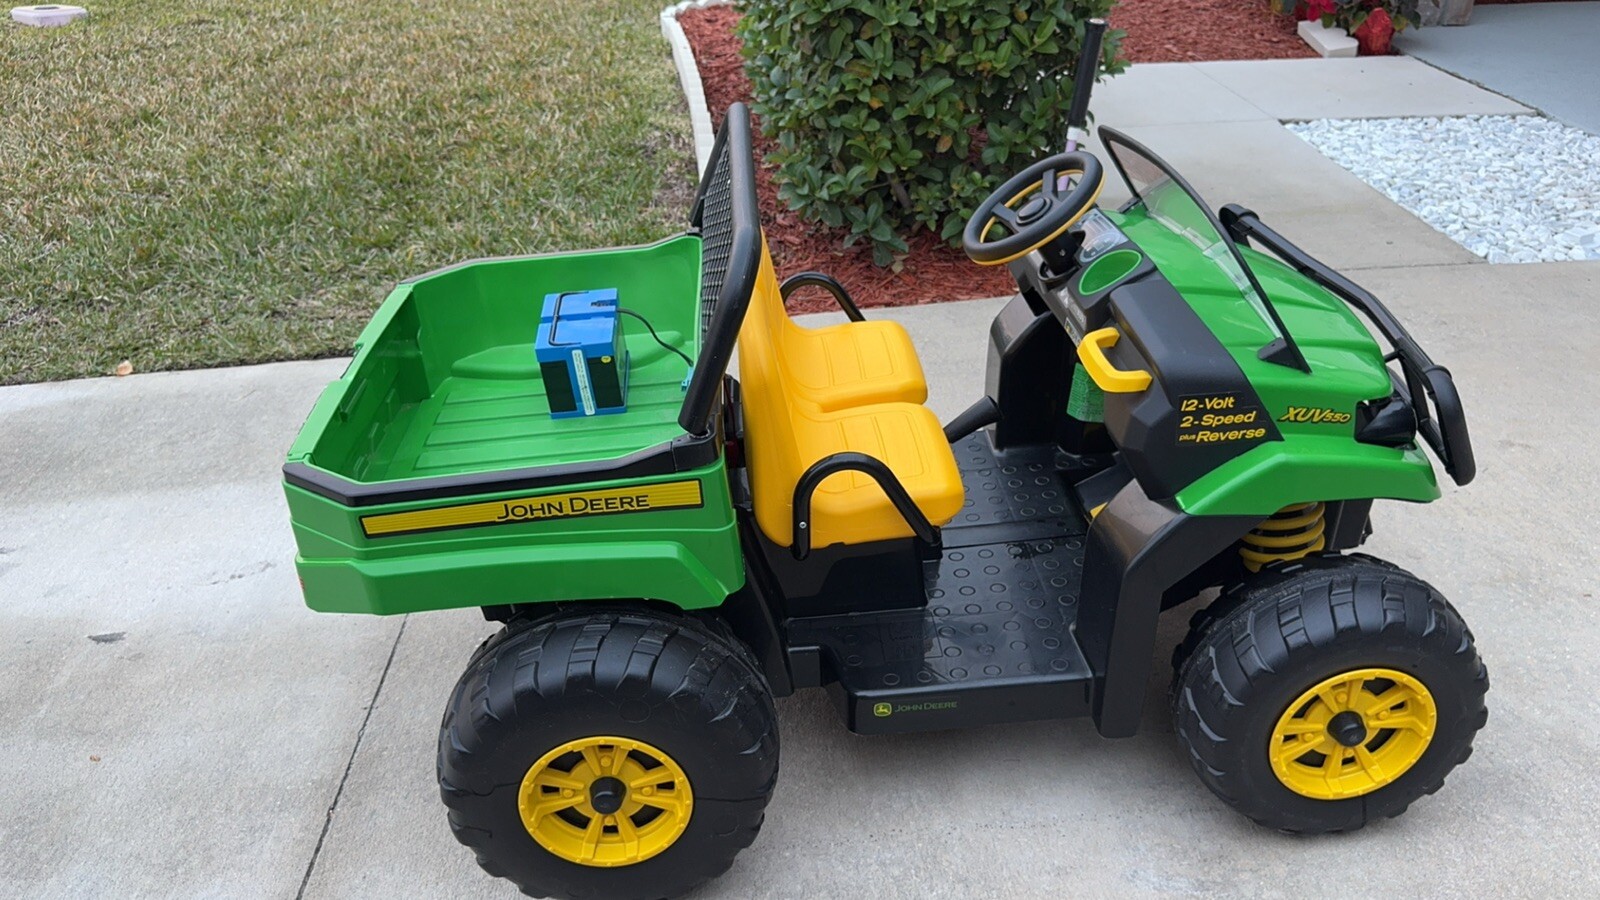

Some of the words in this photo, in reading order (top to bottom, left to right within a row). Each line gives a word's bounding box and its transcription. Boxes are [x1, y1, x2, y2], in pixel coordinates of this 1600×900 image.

[1181, 396, 1235, 412] 12-Volt
[1180, 411, 1256, 427] 2-Speed
[1179, 433, 1196, 442] plus
[1196, 427, 1266, 443] Reverse
[498, 502, 562, 519] JOHN
[570, 495, 649, 512] DEERE
[895, 704, 922, 712] JOHN
[924, 701, 957, 710] DEERE
